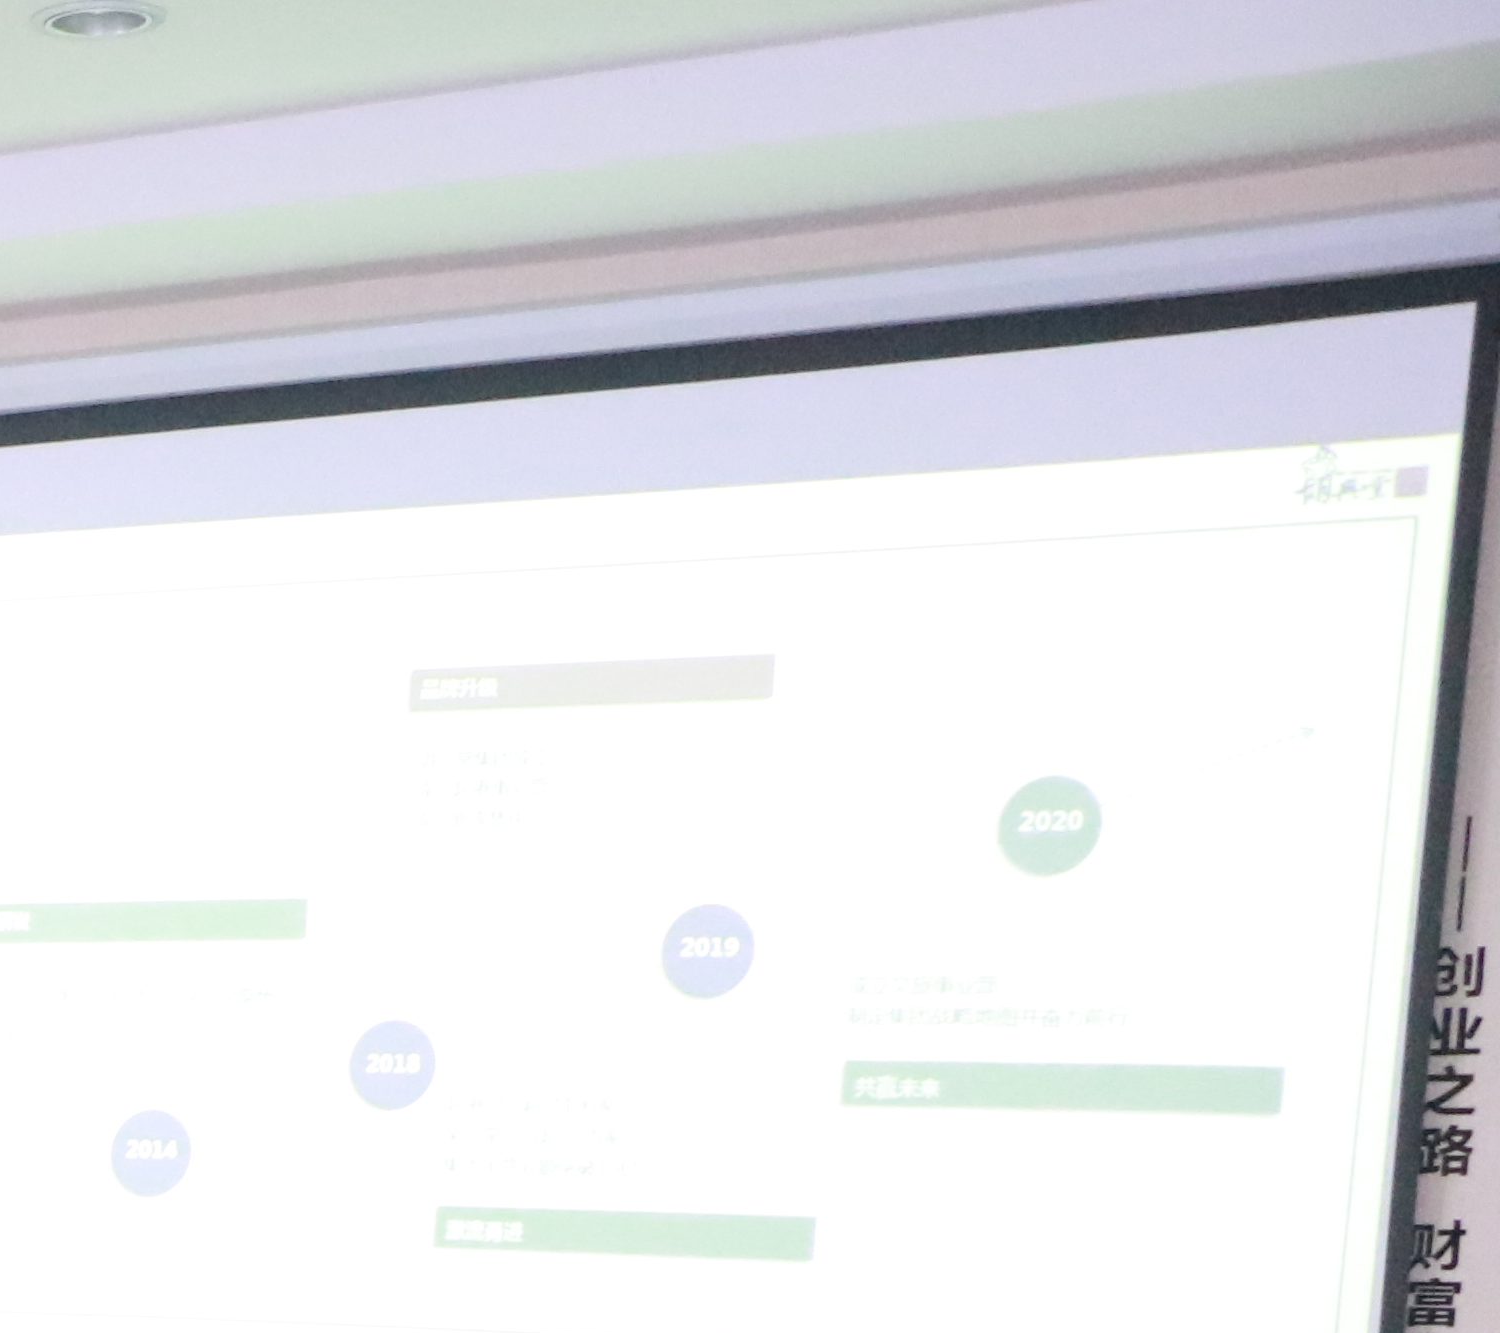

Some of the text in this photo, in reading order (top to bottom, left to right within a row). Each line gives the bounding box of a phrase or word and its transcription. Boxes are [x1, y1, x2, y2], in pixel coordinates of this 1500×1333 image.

[1018, 808, 1085, 834] 2020
[679, 935, 741, 960] 2019
[365, 1051, 421, 1075] 2018
[1419, 946, 1486, 1177] 创业之路
[125, 1138, 178, 1161] 2014
